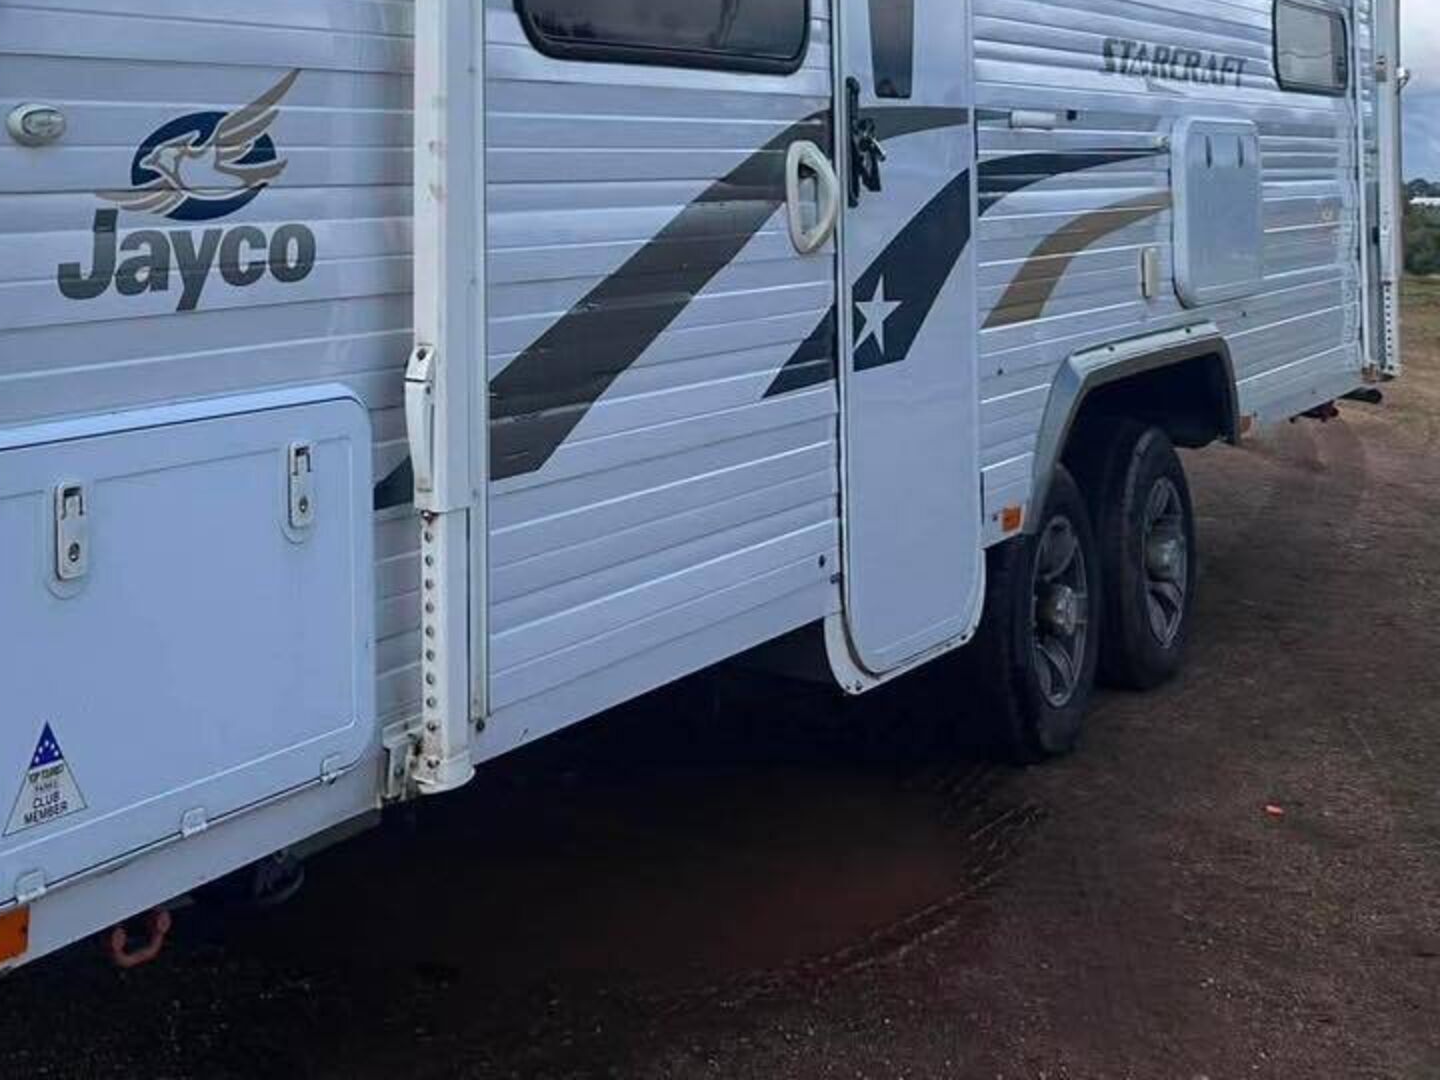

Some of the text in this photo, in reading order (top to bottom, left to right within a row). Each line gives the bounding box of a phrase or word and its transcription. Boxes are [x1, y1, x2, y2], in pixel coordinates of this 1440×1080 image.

[1101, 37, 1249, 88] STARCRAFT
[57, 208, 317, 313] Jayco
[24, 801, 67, 824] MEMBER
[33, 791, 60, 809] CLUB
